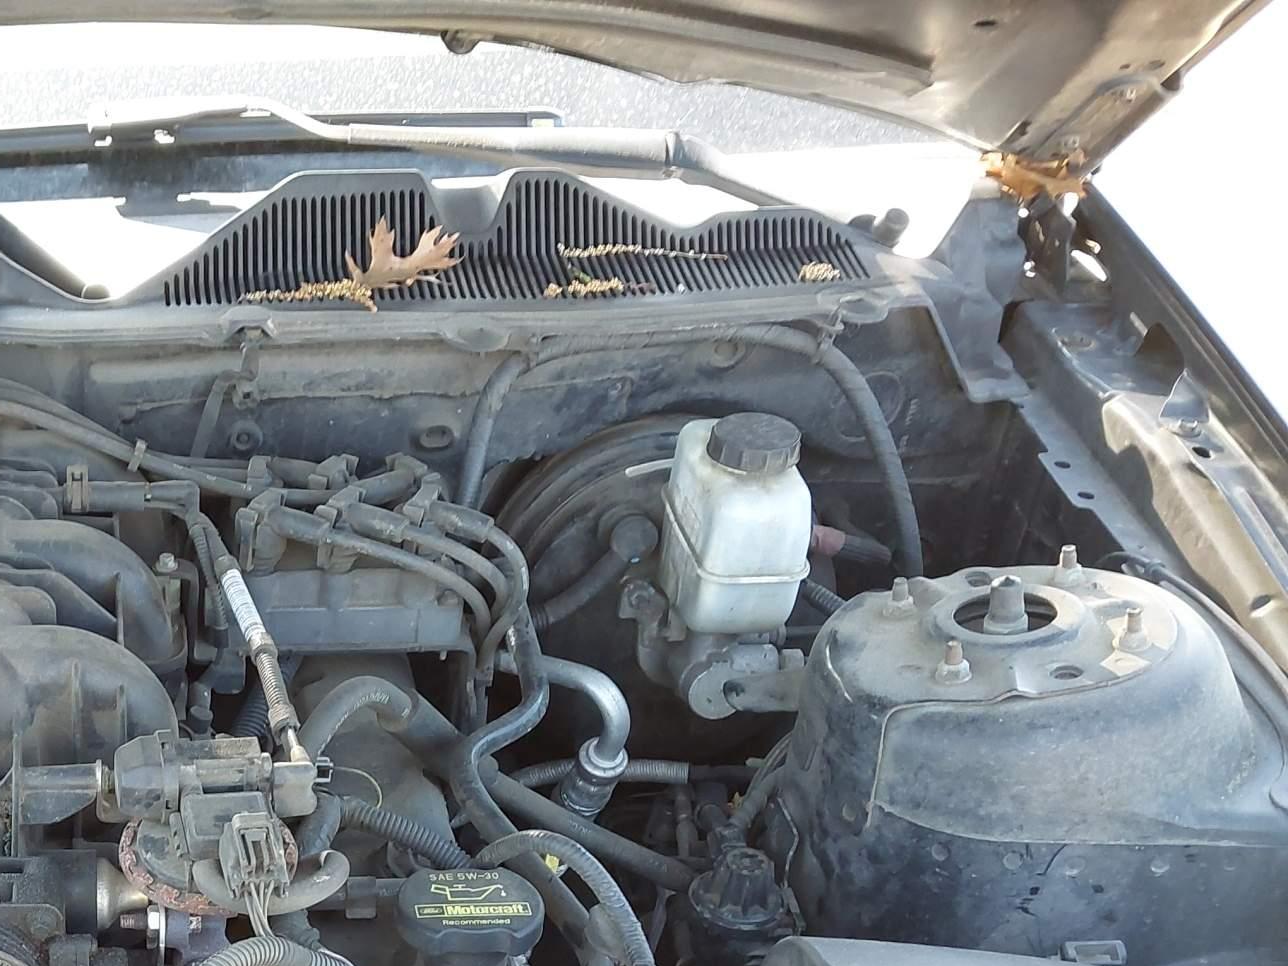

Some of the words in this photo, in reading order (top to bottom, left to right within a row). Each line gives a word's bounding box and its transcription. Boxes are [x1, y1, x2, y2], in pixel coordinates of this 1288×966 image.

[429, 872, 453, 881] SAE
[457, 872, 500, 880] 5W-30
[447, 904, 524, 915] Motorcraft
[443, 918, 511, 926] Recommended
